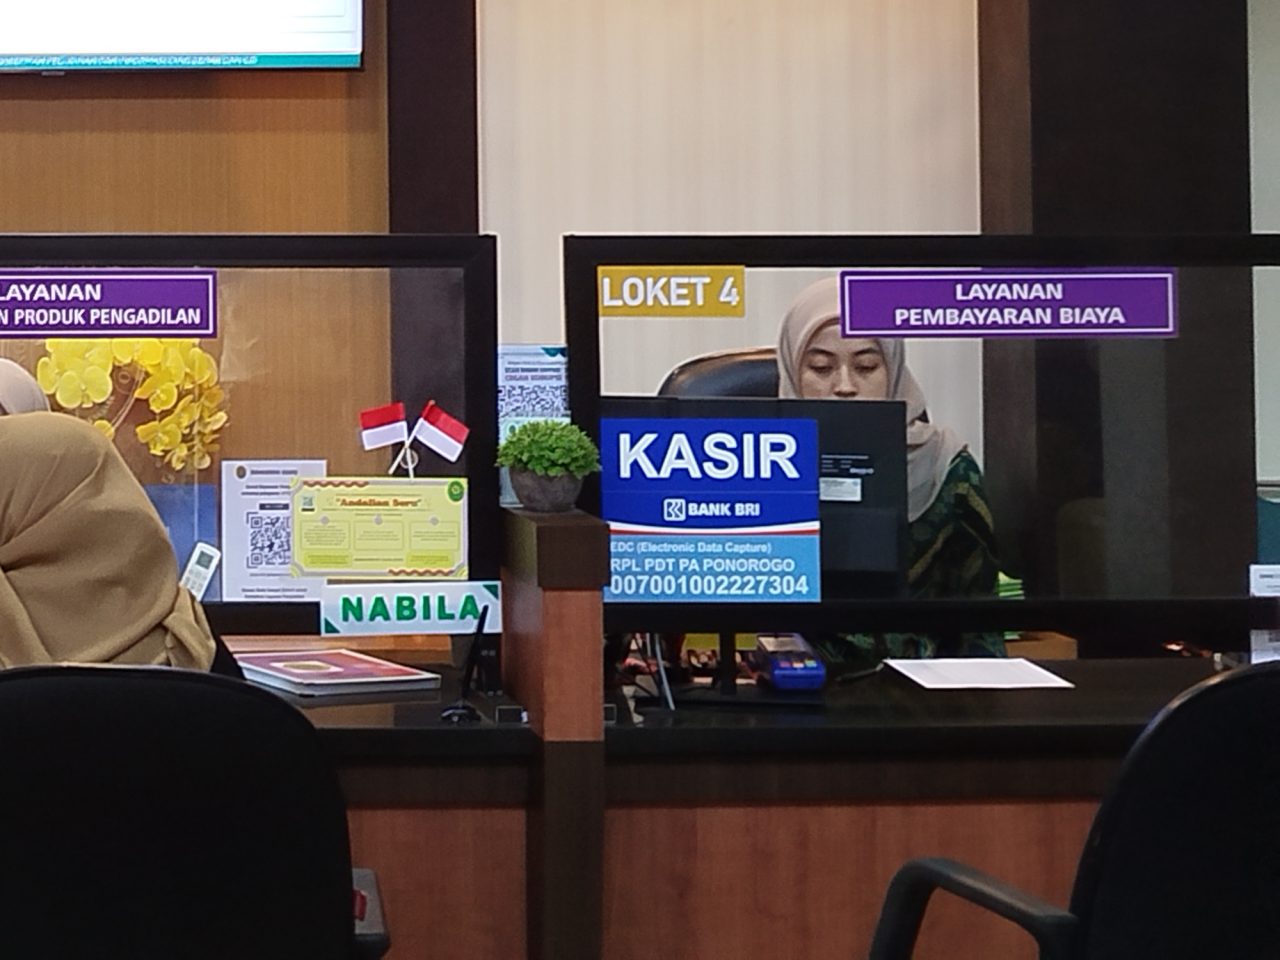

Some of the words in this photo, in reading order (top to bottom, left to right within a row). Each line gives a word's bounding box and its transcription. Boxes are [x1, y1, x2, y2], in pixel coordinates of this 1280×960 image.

[602, 277, 710, 306] LOKET
[719, 276, 739, 305] 4
[955, 283, 1063, 300] LAYANAN
[14, 310, 86, 325] PRODUK
[90, 309, 201, 325] PENGADILAN
[895, 308, 1051, 325] PEMBAYARAN
[1059, 307, 1125, 324] BIAYA
[619, 433, 800, 479] KASIR
[688, 503, 731, 515] BANK
[735, 503, 760, 516] BRI
[610, 541, 634, 553] EDC
[637, 541, 695, 554] (Electronic
[698, 541, 723, 553] Data
[726, 541, 771, 555] Capture)
[611, 559, 640, 572] RPL
[645, 559, 675, 572] PDT
[679, 559, 699, 572] PA
[704, 558, 795, 572] PONOROGO
[611, 575, 809, 595] 007001002227304
[341, 595, 480, 622] NABILA
